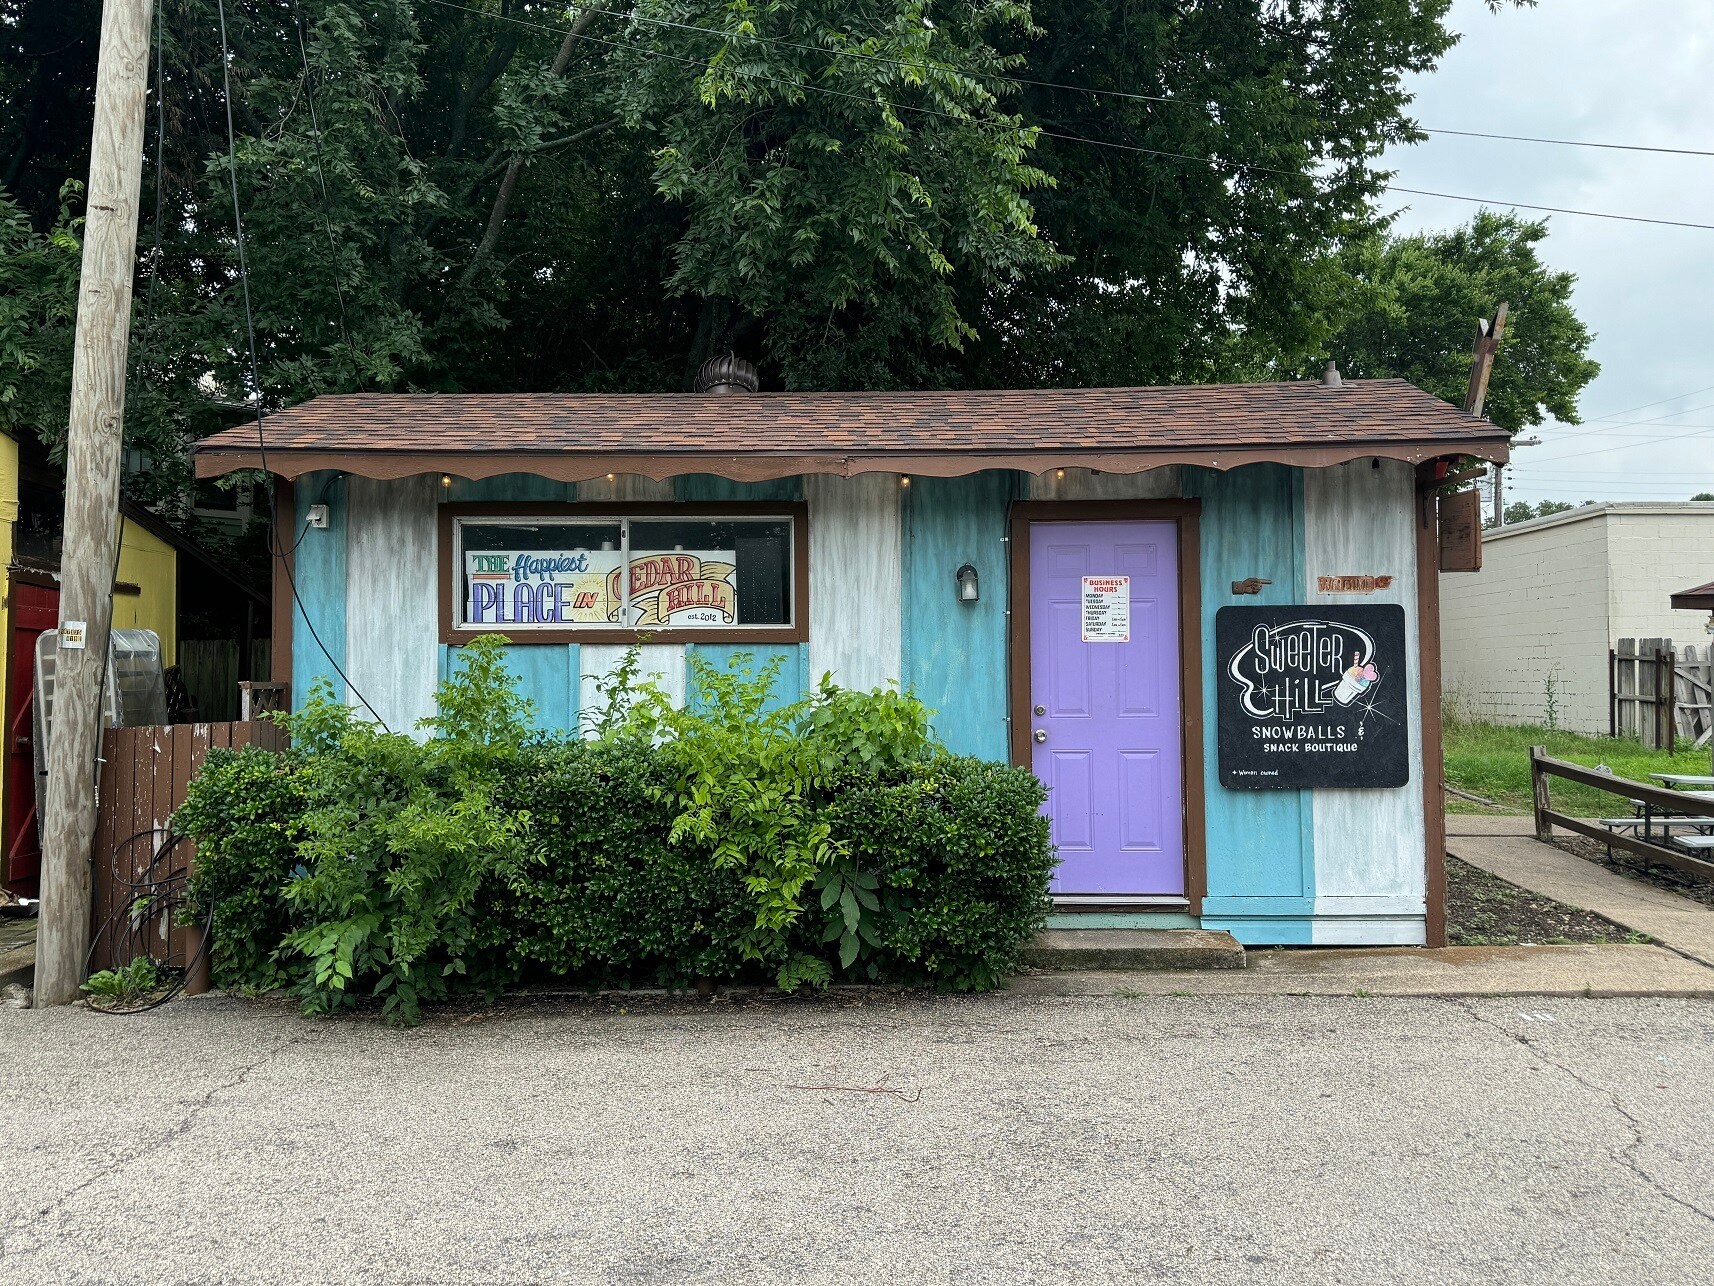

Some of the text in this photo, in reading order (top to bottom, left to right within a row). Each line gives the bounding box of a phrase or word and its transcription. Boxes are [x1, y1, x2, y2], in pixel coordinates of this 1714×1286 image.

[472, 552, 589, 582] THE Happiest
[473, 582, 599, 623] PLACE IN
[666, 581, 726, 612] HILL
[700, 612, 717, 622] 2012
[1251, 721, 1365, 740] SNOWBALLS &
[1263, 742, 1358, 753] SNACK BOUTIQUE
